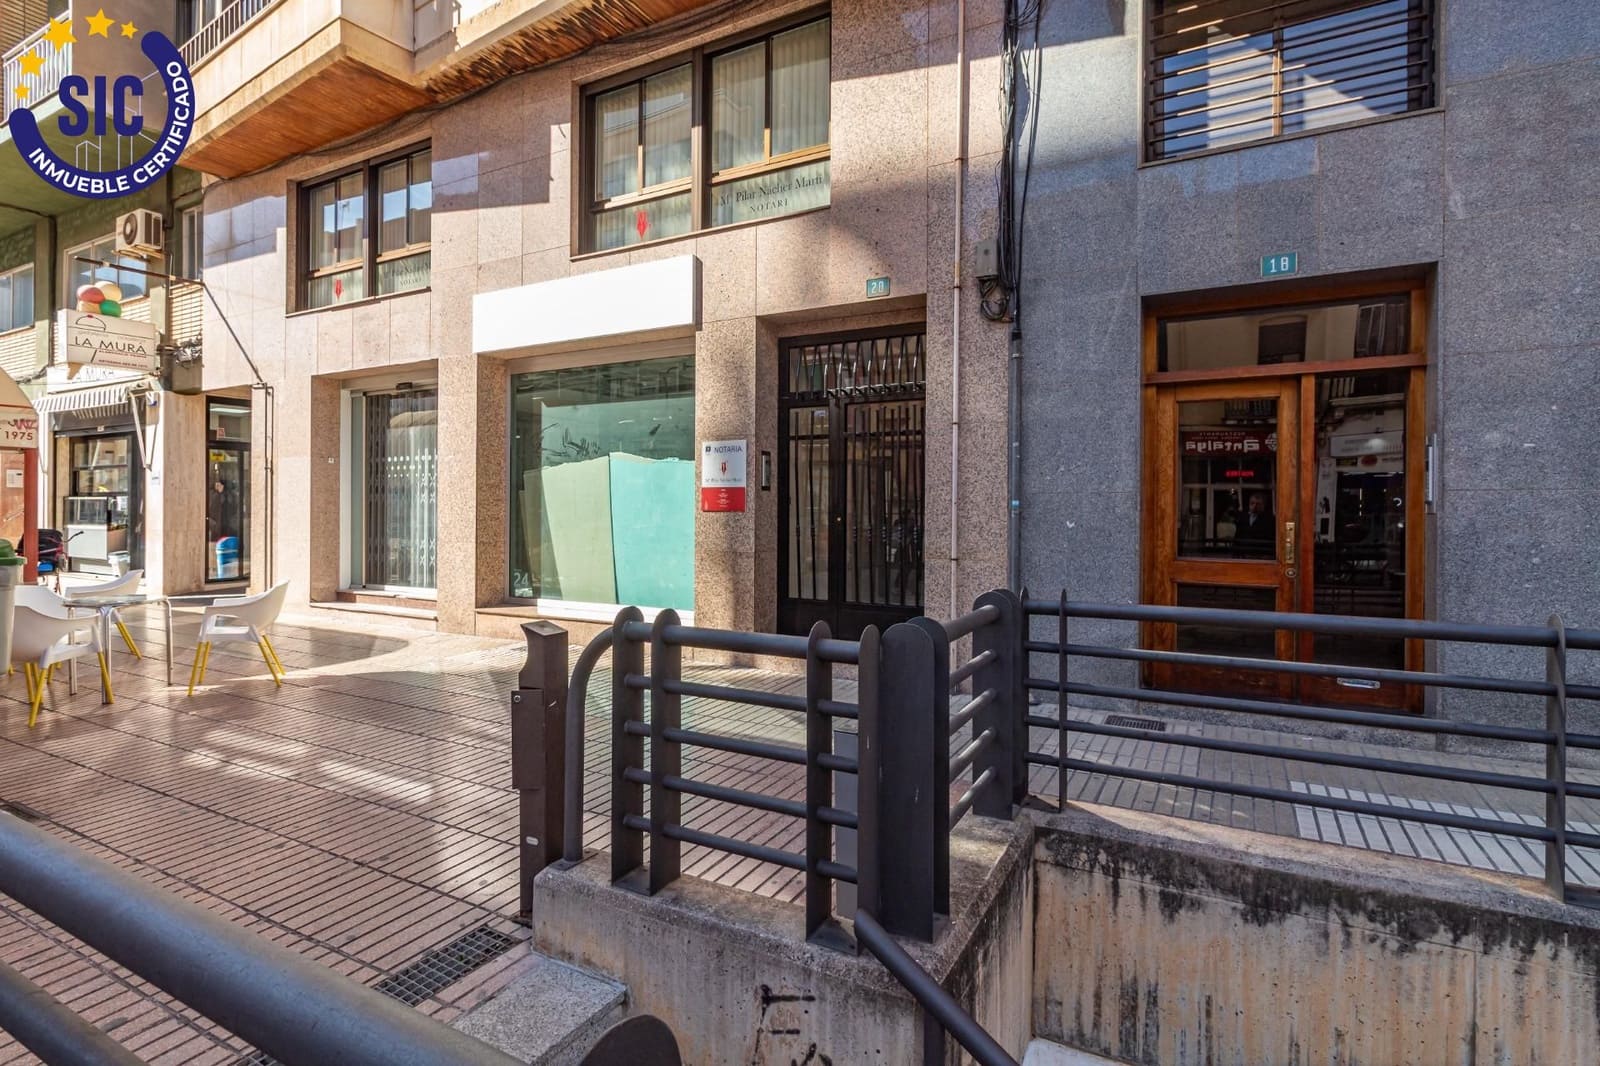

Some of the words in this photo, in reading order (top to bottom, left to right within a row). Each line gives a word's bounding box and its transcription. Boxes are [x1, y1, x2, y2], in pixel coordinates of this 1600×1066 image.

[1270, 256, 1289, 272] 18
[871, 281, 884, 293] 20
[75, 336, 92, 347] LA
[5, 431, 33, 440] 1975
[513, 572, 528, 587] 24
